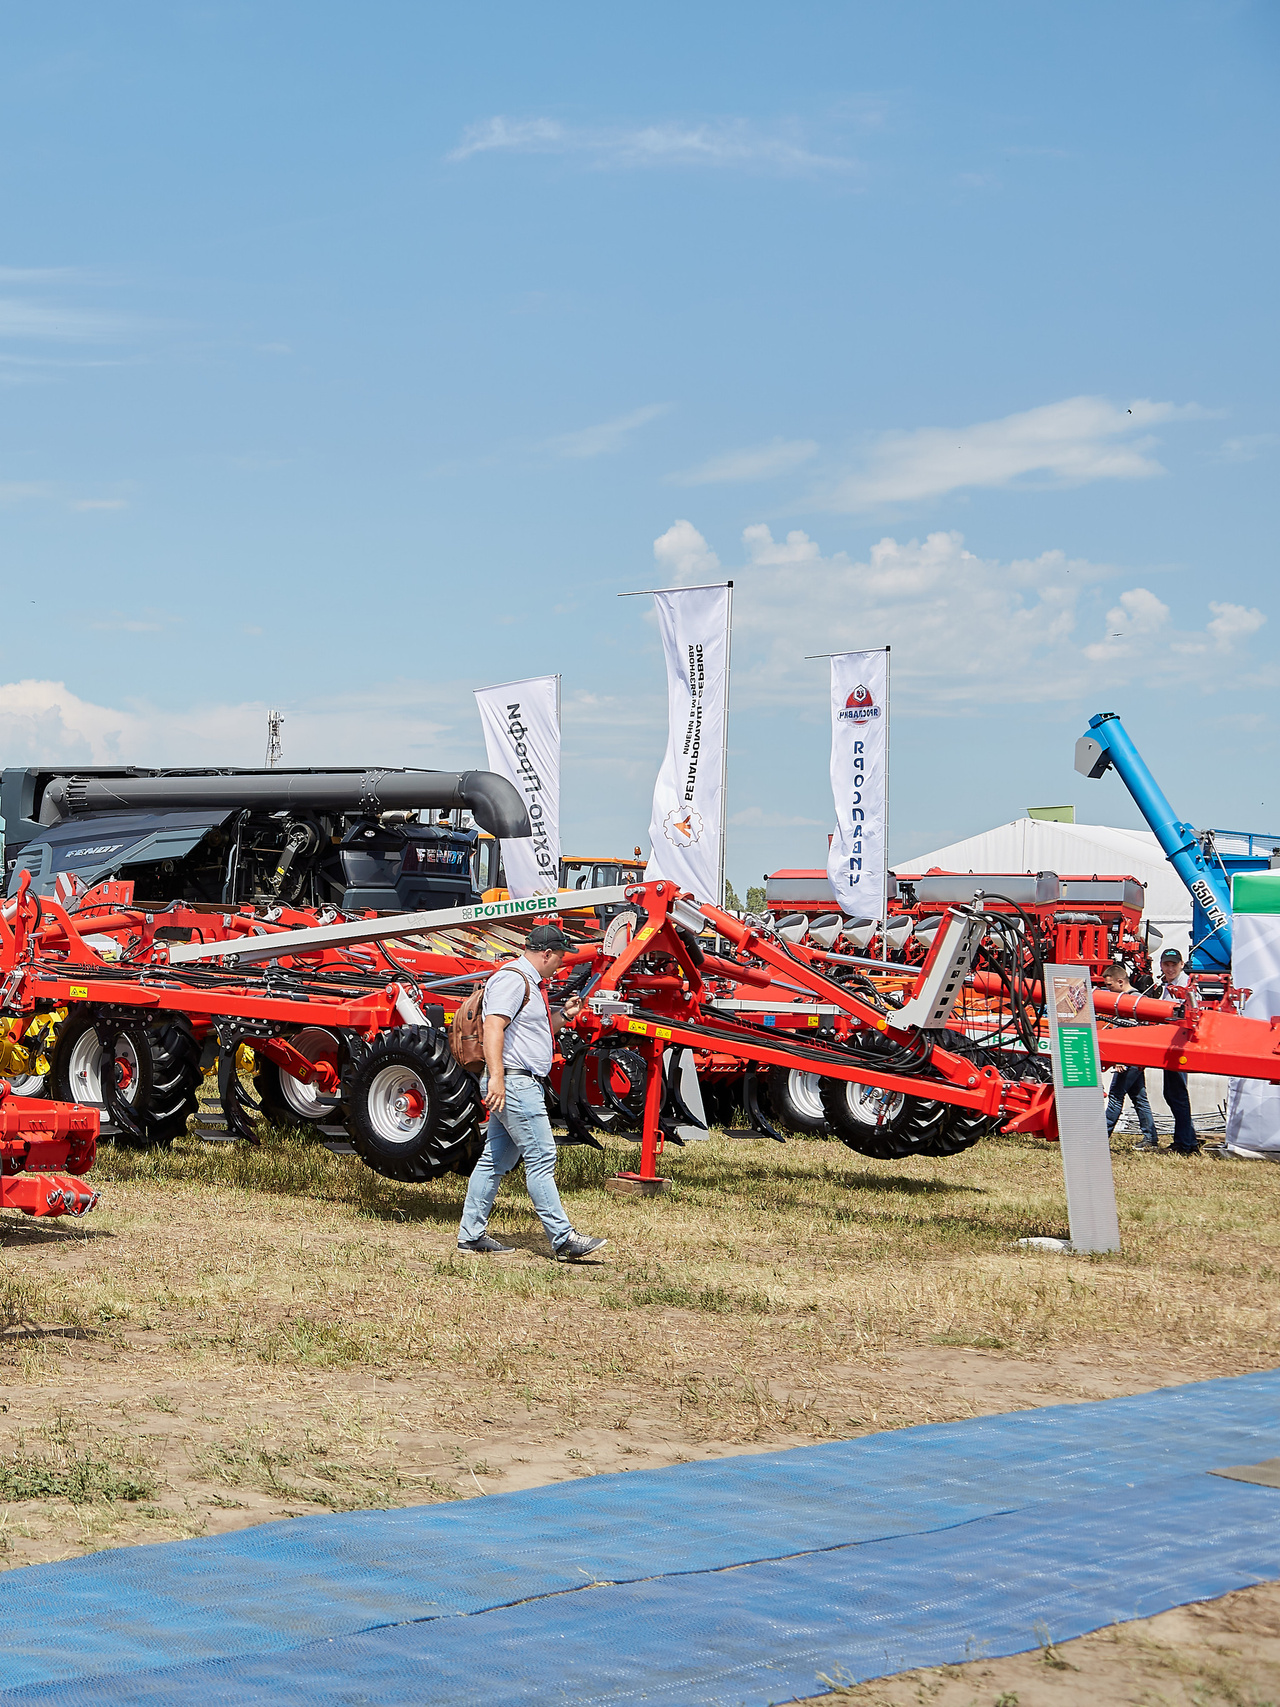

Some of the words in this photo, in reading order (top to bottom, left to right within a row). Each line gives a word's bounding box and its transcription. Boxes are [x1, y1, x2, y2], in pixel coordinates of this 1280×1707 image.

[64, 844, 124, 858] FENDT
[415, 847, 466, 865] FENDT
[1191, 880, 1216, 908] 350
[474, 896, 558, 918] PÖTTINGER
